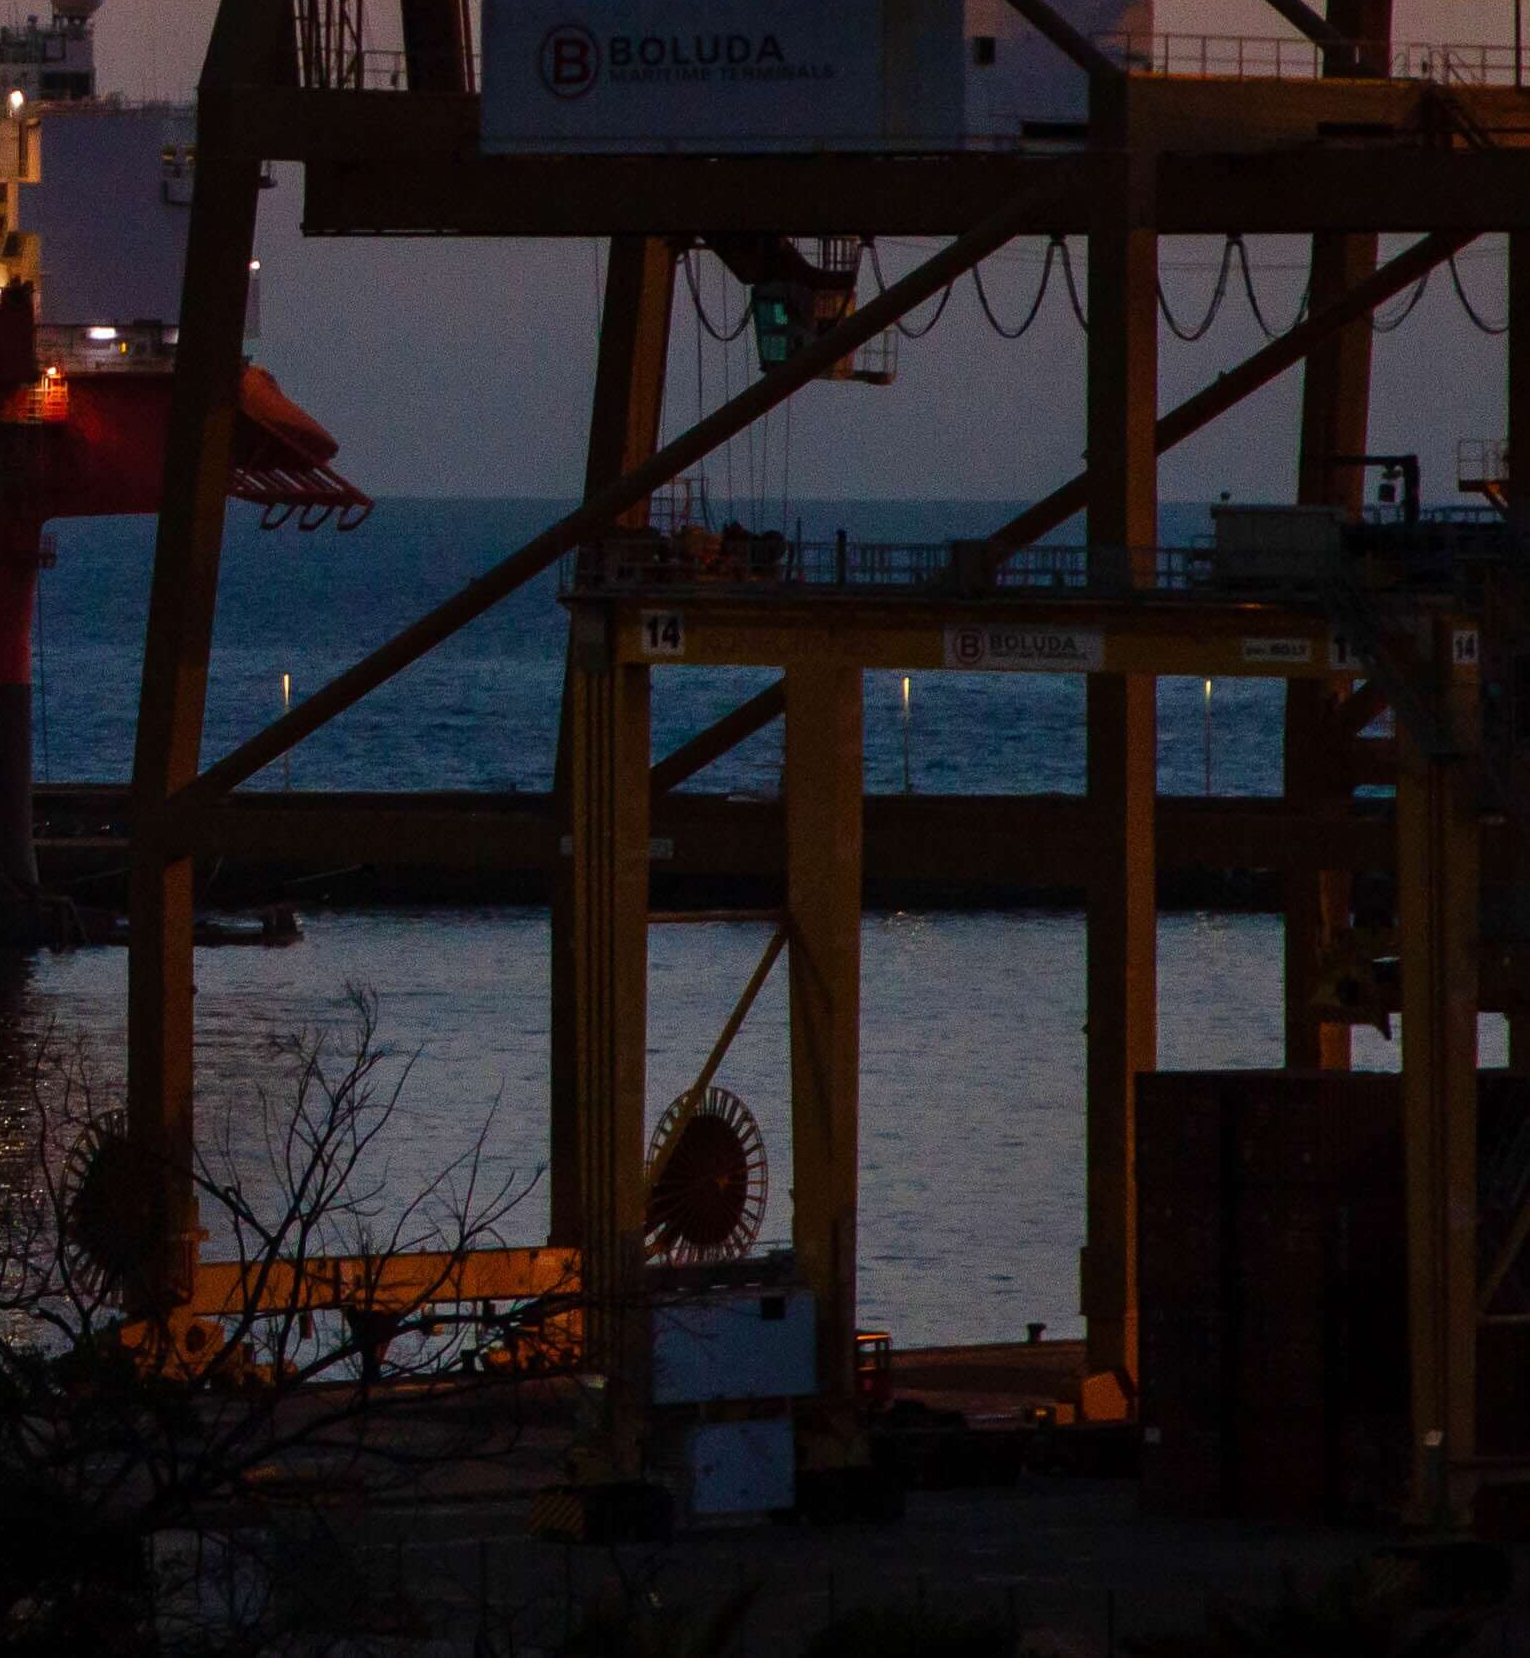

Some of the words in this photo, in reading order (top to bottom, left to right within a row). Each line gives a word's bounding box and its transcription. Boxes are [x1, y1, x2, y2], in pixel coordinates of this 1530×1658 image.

[611, 35, 785, 65] BOLUDA
[648, 616, 680, 648] 14
[990, 635, 1077, 652] BOLUDA
[1455, 634, 1476, 659] 14
